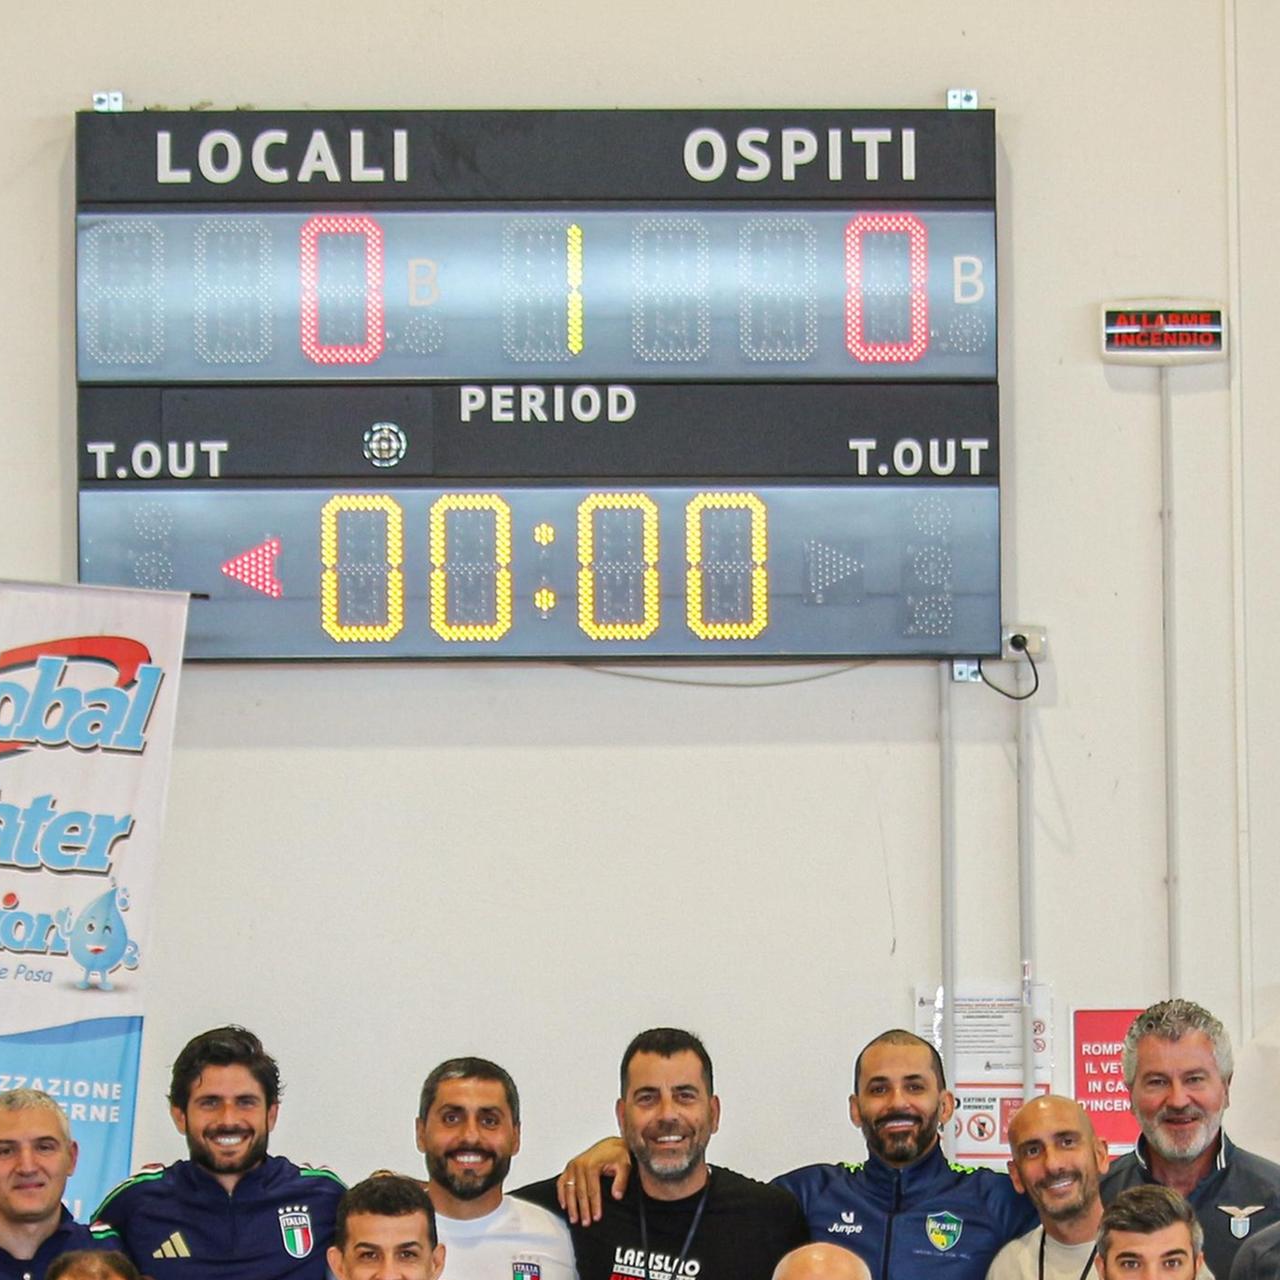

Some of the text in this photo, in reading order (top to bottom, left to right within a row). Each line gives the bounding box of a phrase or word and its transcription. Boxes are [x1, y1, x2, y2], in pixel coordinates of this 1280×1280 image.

[157, 129, 408, 183] LOCALI
[683, 128, 916, 181] OSPITI
[300, 216, 384, 364] 0
[845, 214, 929, 362] 0
[953, 256, 986, 304] B
[1116, 313, 1212, 326] ALLARME
[1114, 332, 1215, 347] INCENDIO
[460, 385, 636, 422] PERIOD
[87, 441, 228, 478] T.OUT
[849, 439, 989, 475] T.OUT
[320, 493, 768, 642] 00:00
[14, 963, 54, 984] Posa
[1082, 1043, 1125, 1055] ROMP
[1085, 1062, 1124, 1074] IL VET
[1088, 1081, 1129, 1093] IN CA
[1078, 1101, 1131, 1112] D'INCEN
[282, 1215, 308, 1227] ITALIA
[513, 1263, 539, 1274] ITALIA
